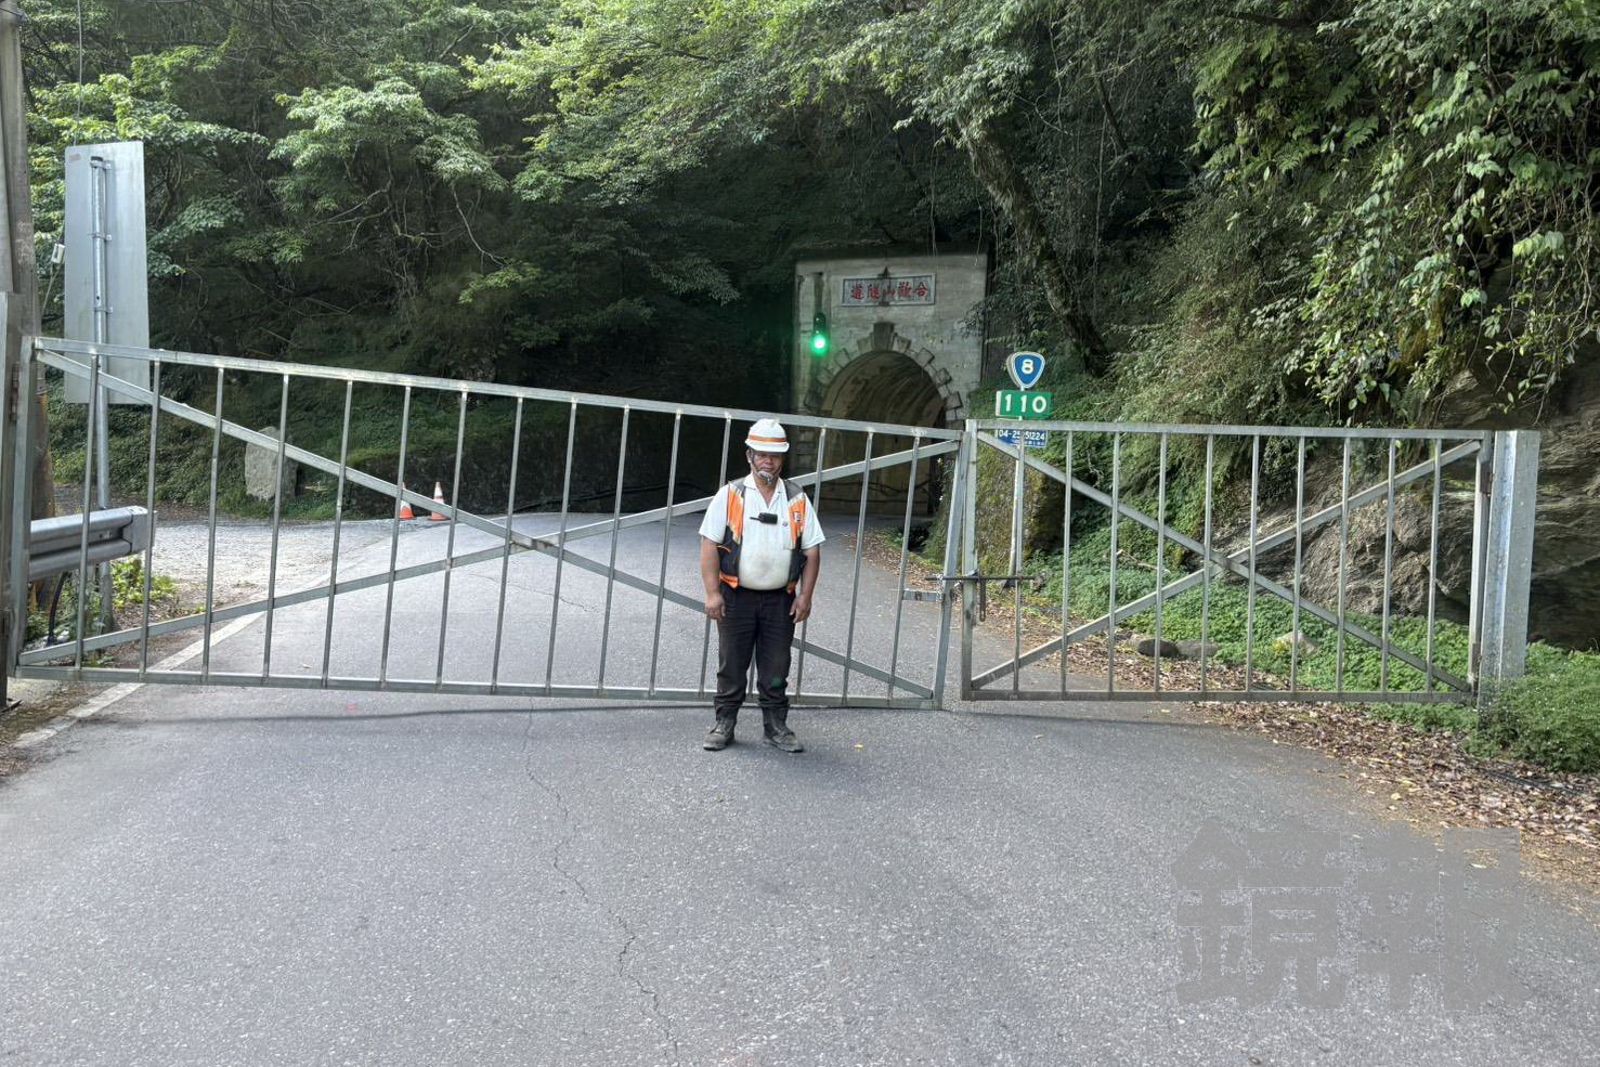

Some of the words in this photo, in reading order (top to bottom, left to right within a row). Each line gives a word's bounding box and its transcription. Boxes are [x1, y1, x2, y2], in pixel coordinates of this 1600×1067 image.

[1021, 358, 1034, 374] 8
[1004, 393, 1047, 413] 110
[998, 429, 1045, 441] 04-2551224
